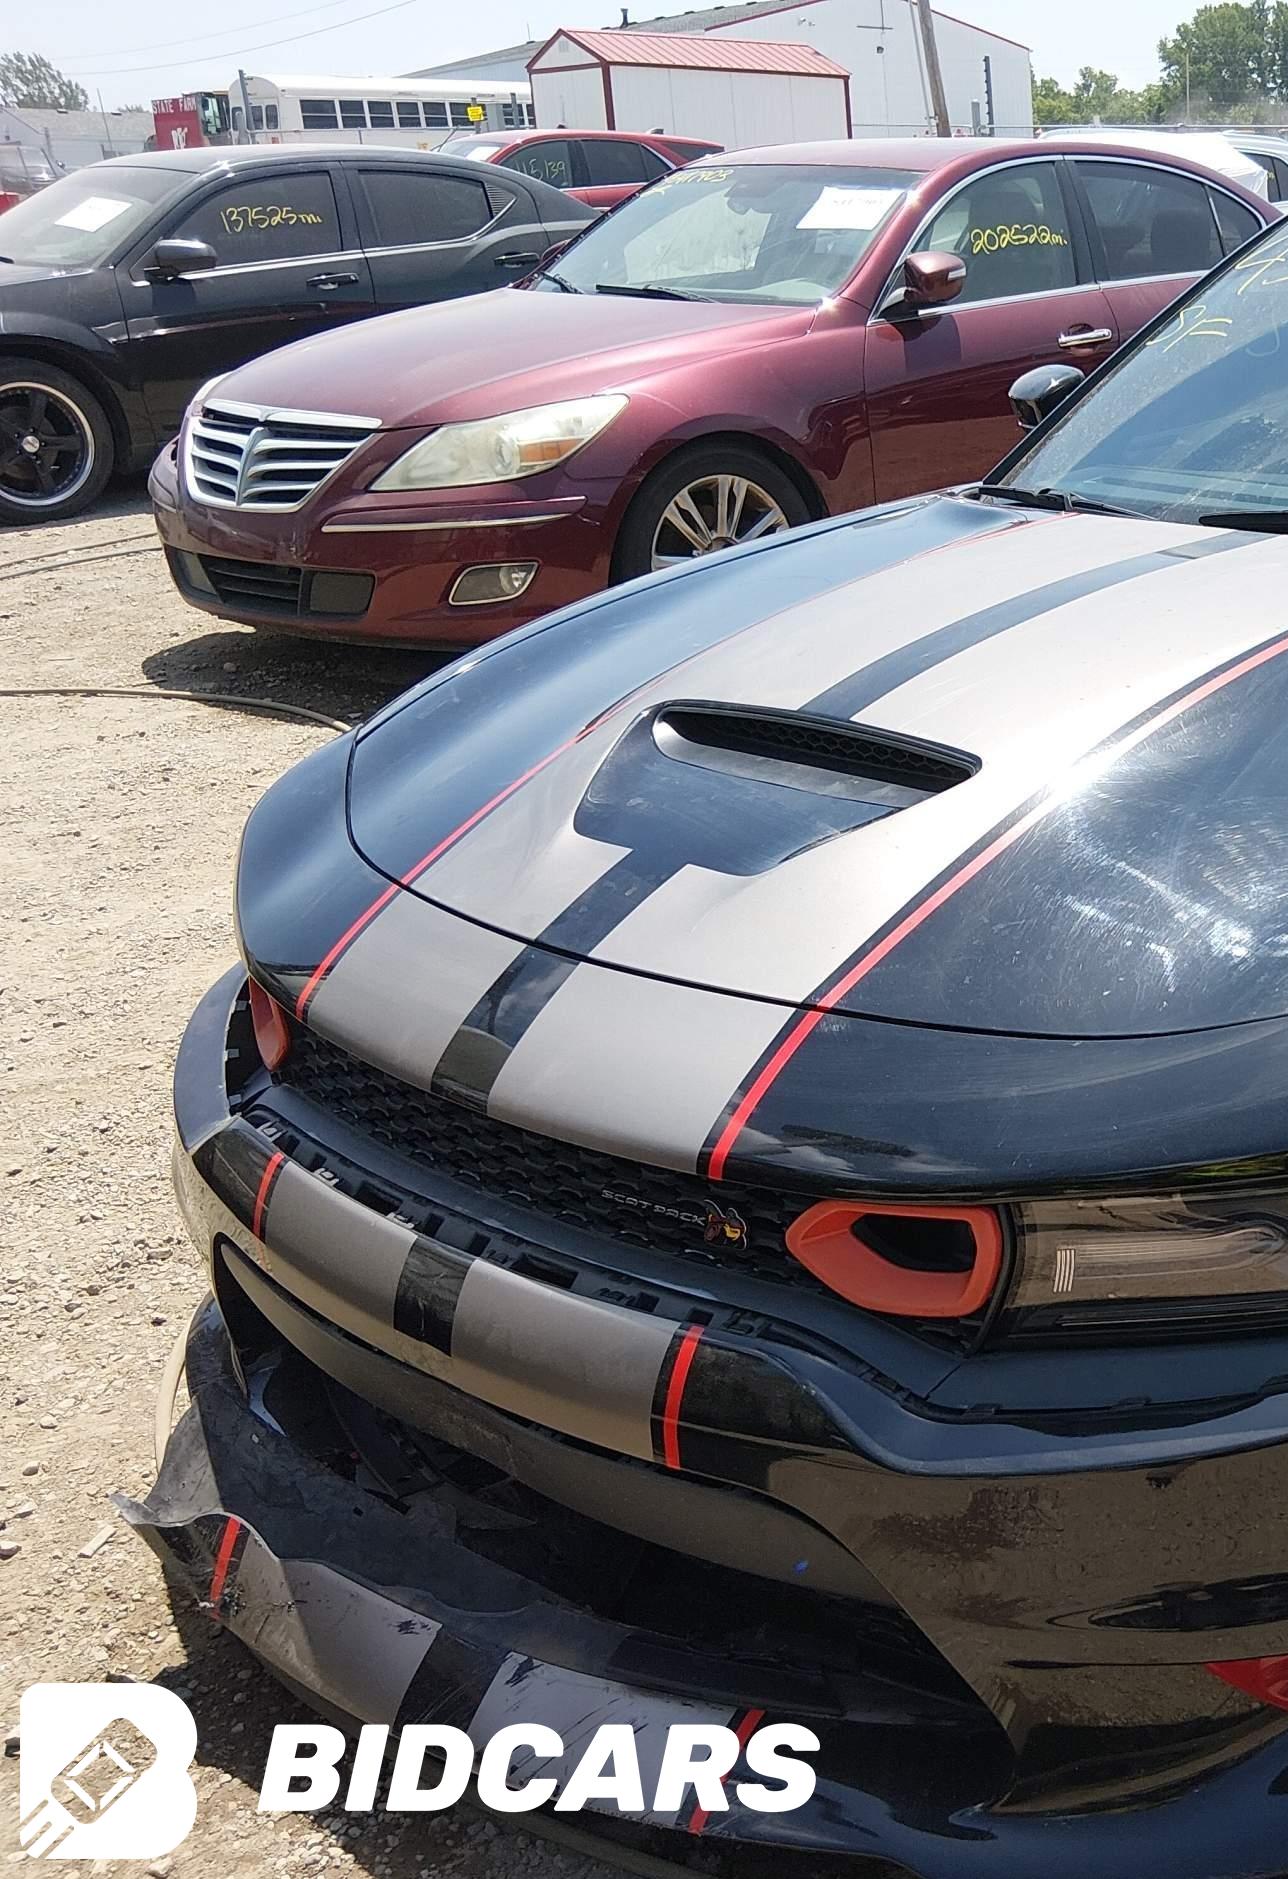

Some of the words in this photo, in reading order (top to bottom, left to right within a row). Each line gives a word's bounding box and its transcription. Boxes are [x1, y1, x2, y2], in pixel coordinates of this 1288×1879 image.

[151, 99, 174, 114] STATE
[601, 1189, 651, 1208] SCAT
[653, 1205, 705, 1226] PACK
